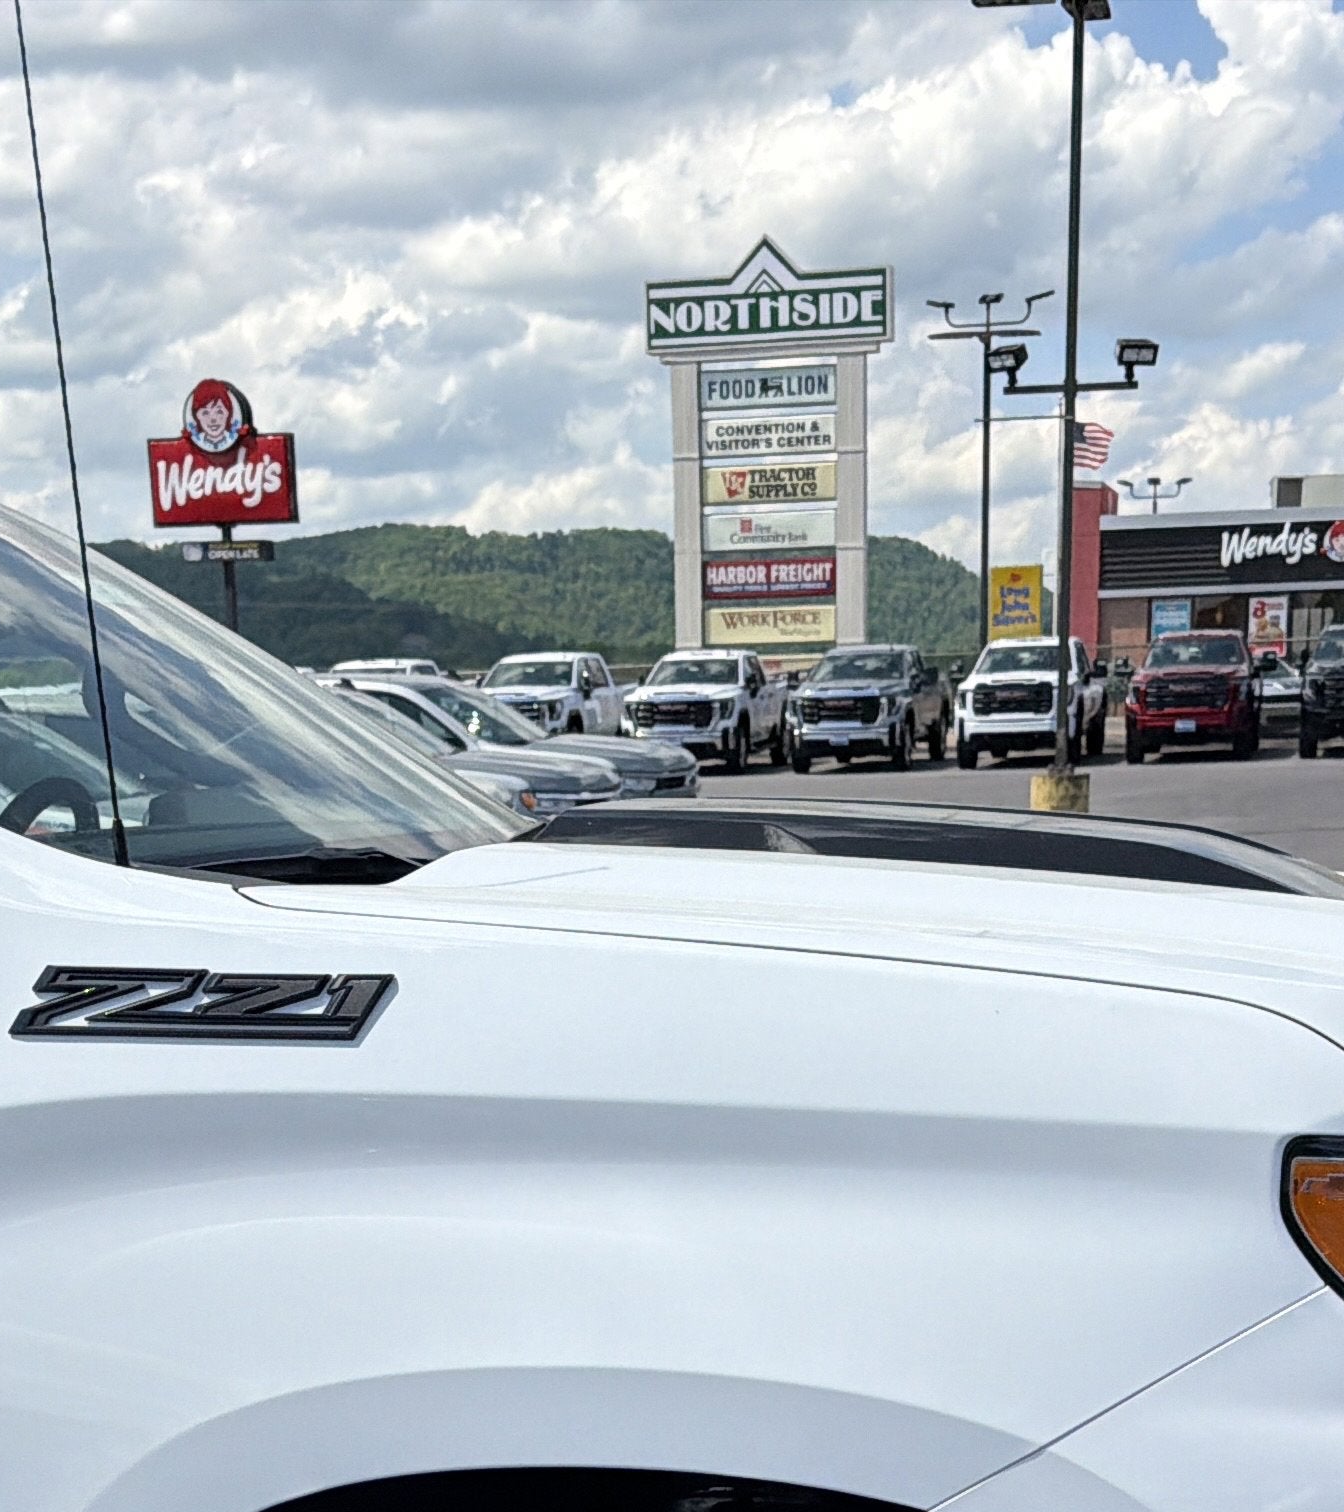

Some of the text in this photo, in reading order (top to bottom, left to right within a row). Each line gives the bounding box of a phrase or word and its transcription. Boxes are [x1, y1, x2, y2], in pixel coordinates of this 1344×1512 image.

[650, 290, 883, 335] NORTHSIDE
[708, 374, 829, 401] FOOD LION
[715, 420, 820, 437] CONVENTION &
[706, 434, 832, 451] VISITOR'S CENTER
[156, 447, 283, 512] Wendy's
[748, 467, 817, 484] TRACTOR
[748, 484, 798, 499] SUPPLY
[1220, 521, 1318, 568] Wendy's
[707, 563, 833, 584] HARBOR FREIGHT
[9, 965, 396, 1042] Z71
